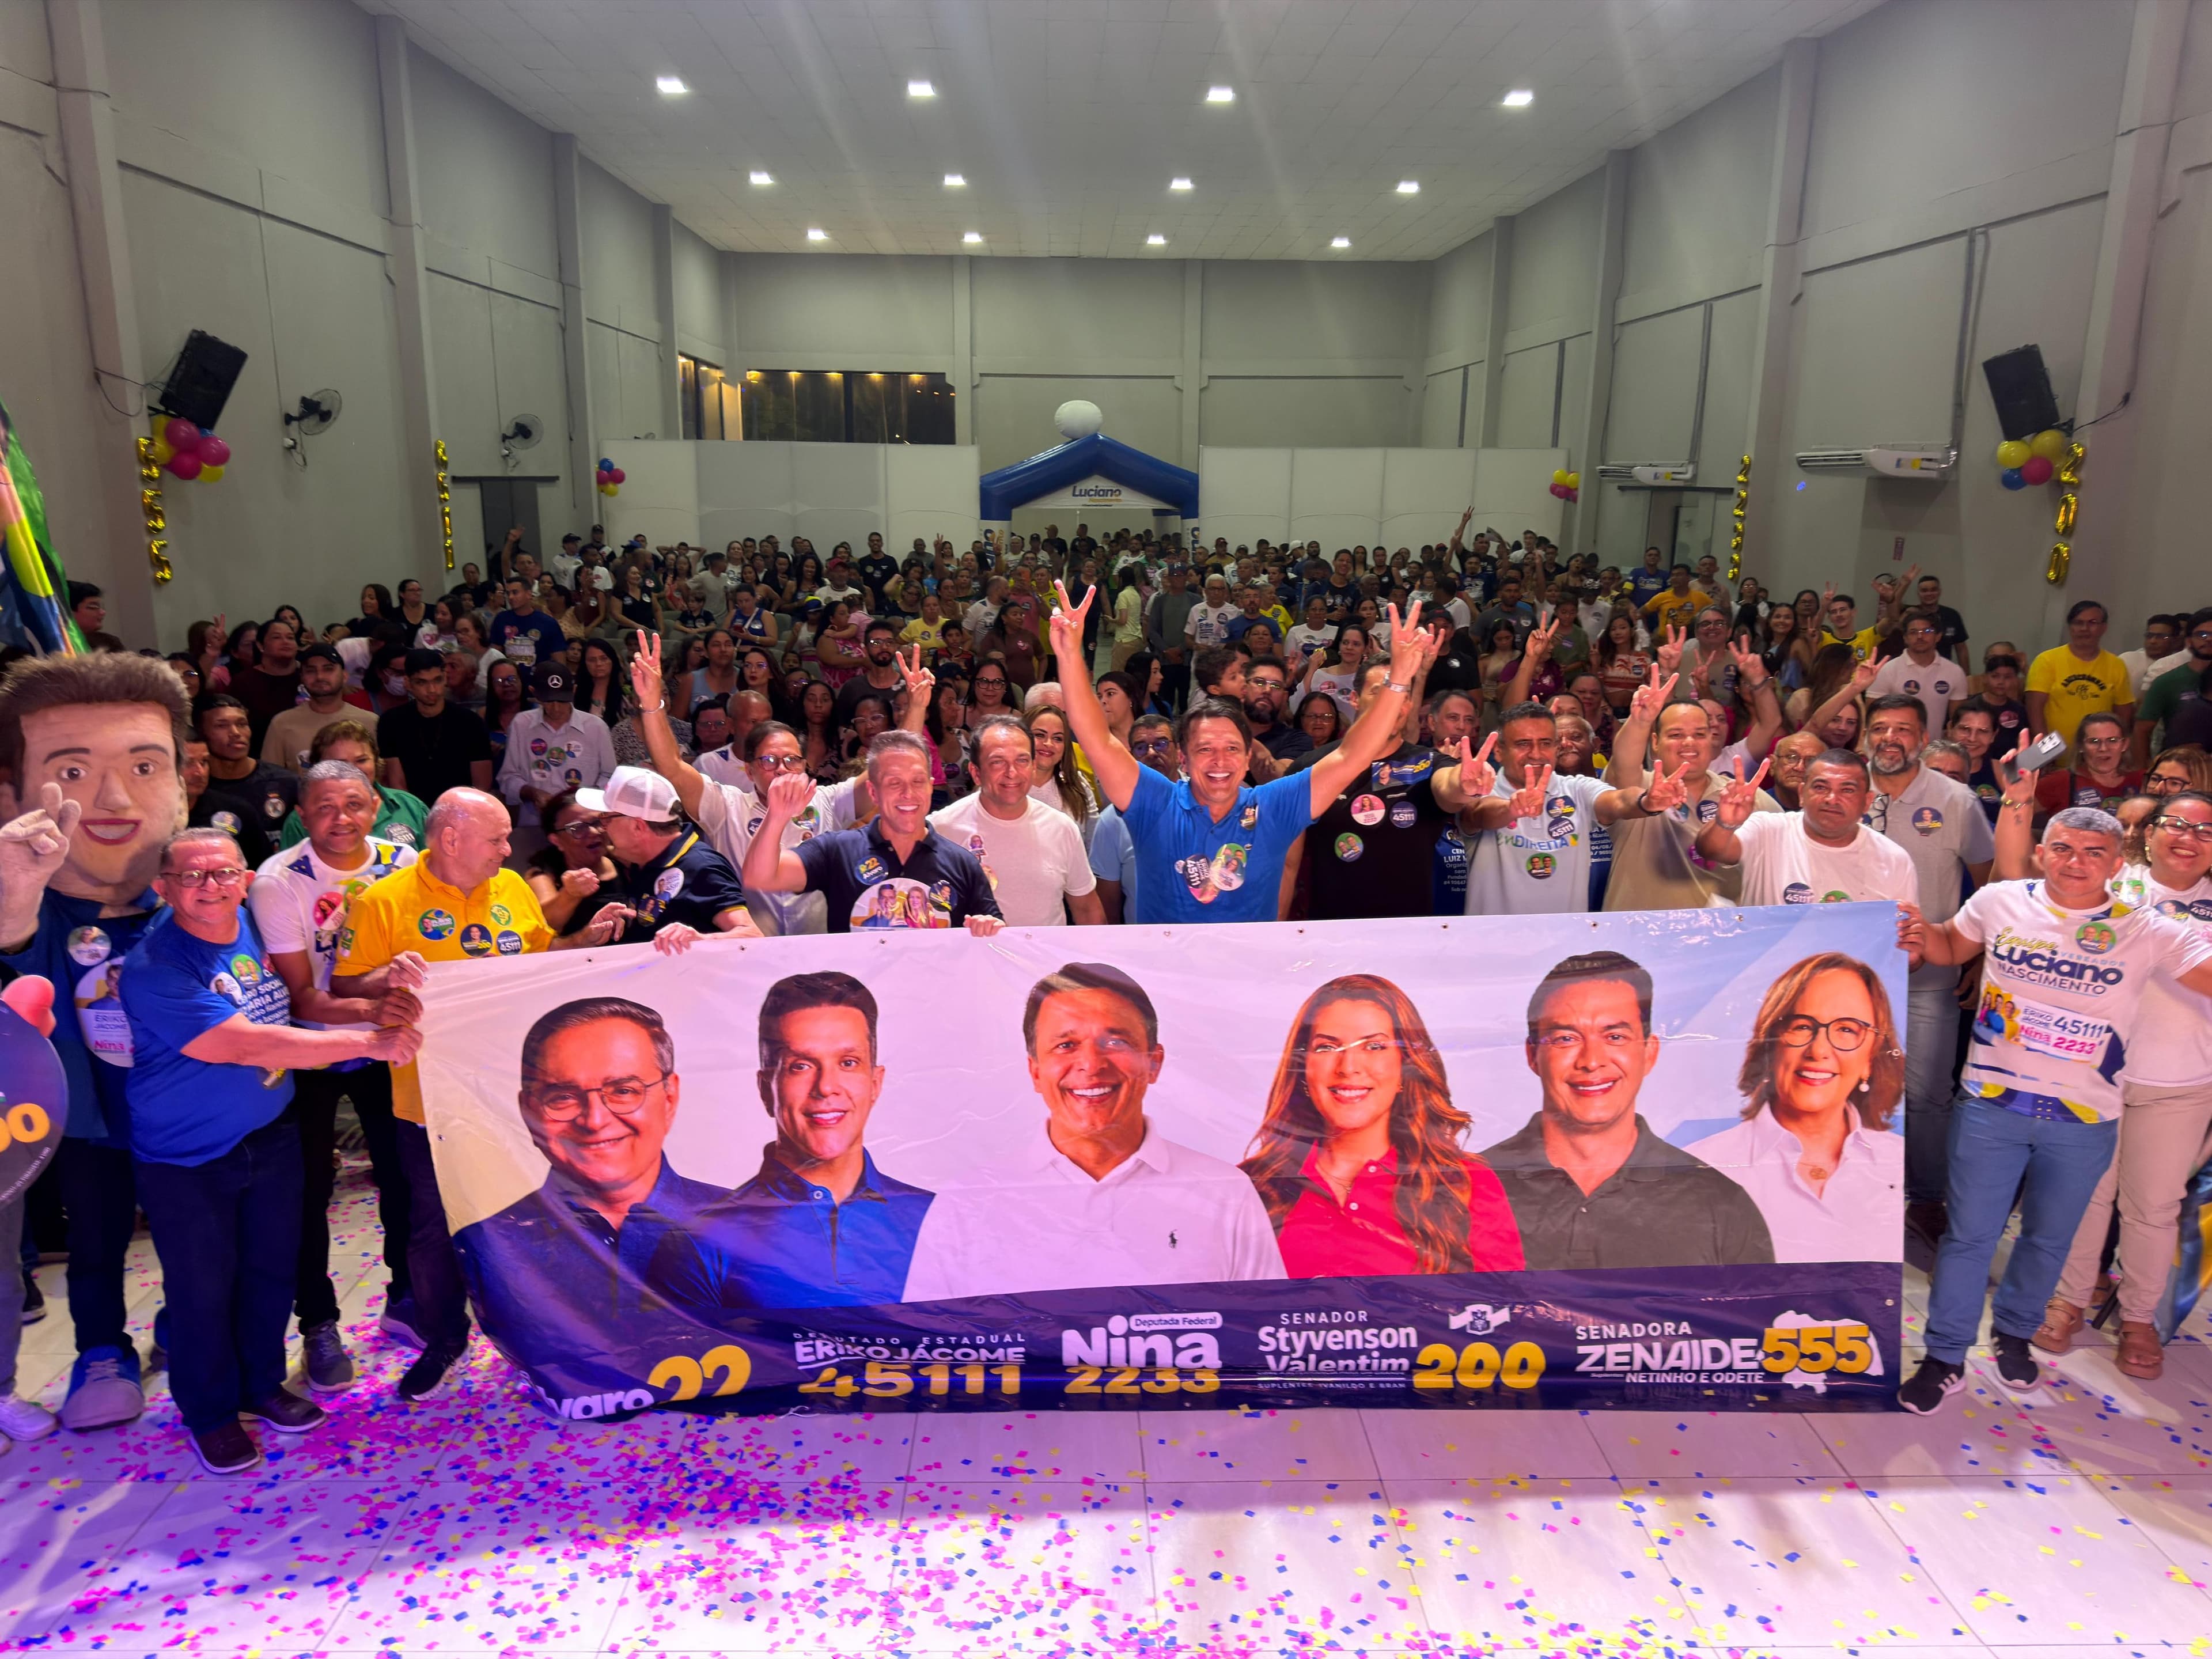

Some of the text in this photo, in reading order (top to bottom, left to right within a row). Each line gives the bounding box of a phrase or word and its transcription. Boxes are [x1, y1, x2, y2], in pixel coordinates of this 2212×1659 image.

[1072, 486, 1122, 497] Luciano
[1996, 926, 2058, 955] Equipe
[1993, 934, 2123, 985] Luciano
[2060, 951, 2126, 967] VEREADOR
[1997, 961, 2107, 995] NASCIMENTO
[2054, 1016, 2105, 1038] 45111
[94, 1040, 126, 1051] Nina
[2020, 1025, 2051, 1042] Nina
[2052, 1037, 2097, 1055] 2233
[1135, 1316, 1217, 1327] Deputada Federal
[1280, 1310, 1368, 1324] SENADOR
[922, 1332, 1025, 1344] ESTADUAL
[1062, 1315, 1222, 1369] Nina
[1258, 1325, 1418, 1358] Styvenson
[1576, 1321, 1692, 1340] SENADORA
[794, 1339, 1027, 1363] ERIKO JÁCOME
[1575, 1325, 1872, 1373] ZENAIDE 555
[1265, 1351, 1410, 1372] Valentim
[1413, 1342, 1546, 1389] 200
[798, 1362, 1021, 1397] 45111
[1064, 1366, 1221, 1394] 2233
[1626, 1372, 1696, 1383] NETINHO
[1700, 1372, 1710, 1382] E
[1711, 1372, 1765, 1383] ODETE
